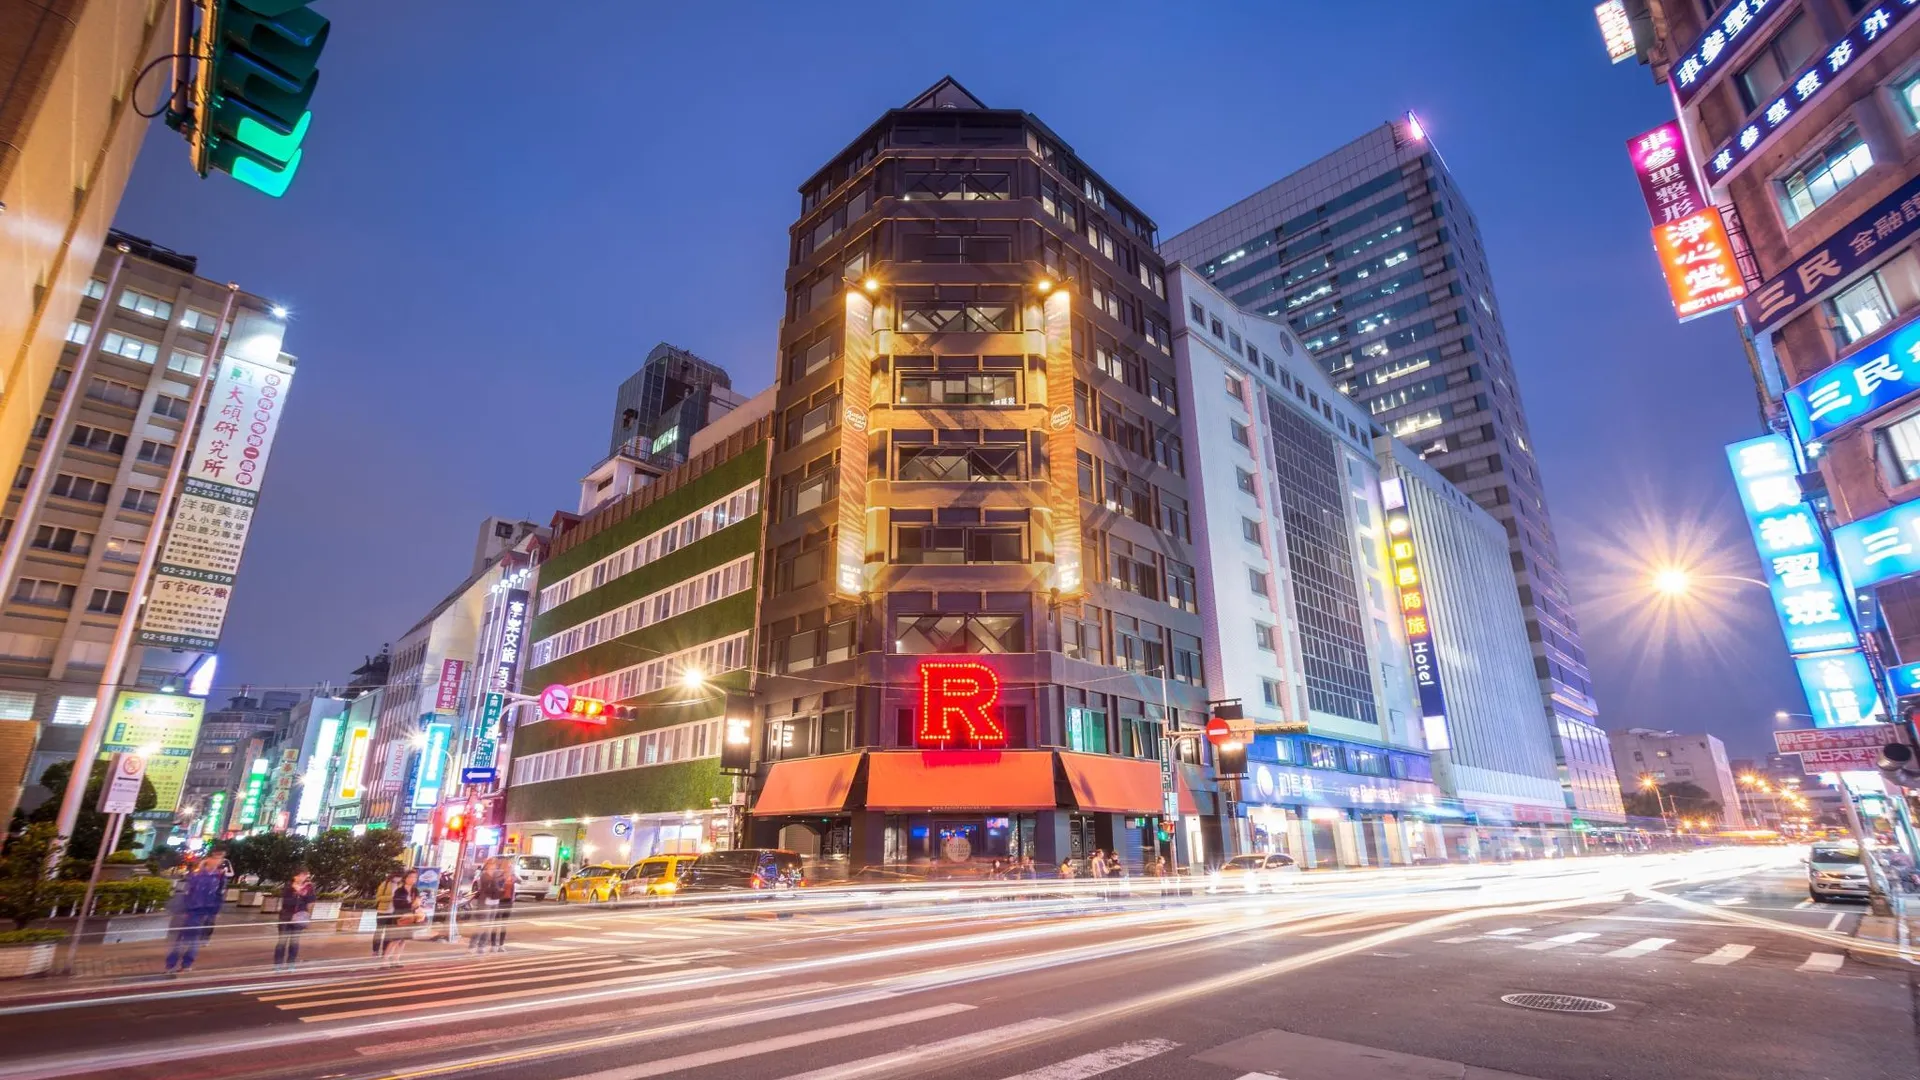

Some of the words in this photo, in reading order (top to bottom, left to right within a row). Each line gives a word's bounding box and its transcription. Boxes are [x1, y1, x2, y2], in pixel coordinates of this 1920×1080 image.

[1757, 249, 1842, 322] 三民
[202, 385, 243, 478] 大碩研究所
[181, 498, 250, 521] 洋碩美語
[1413, 641, 1434, 687] Hotel
[920, 662, 1004, 741] R
[391, 743, 405, 777] PENTAX
